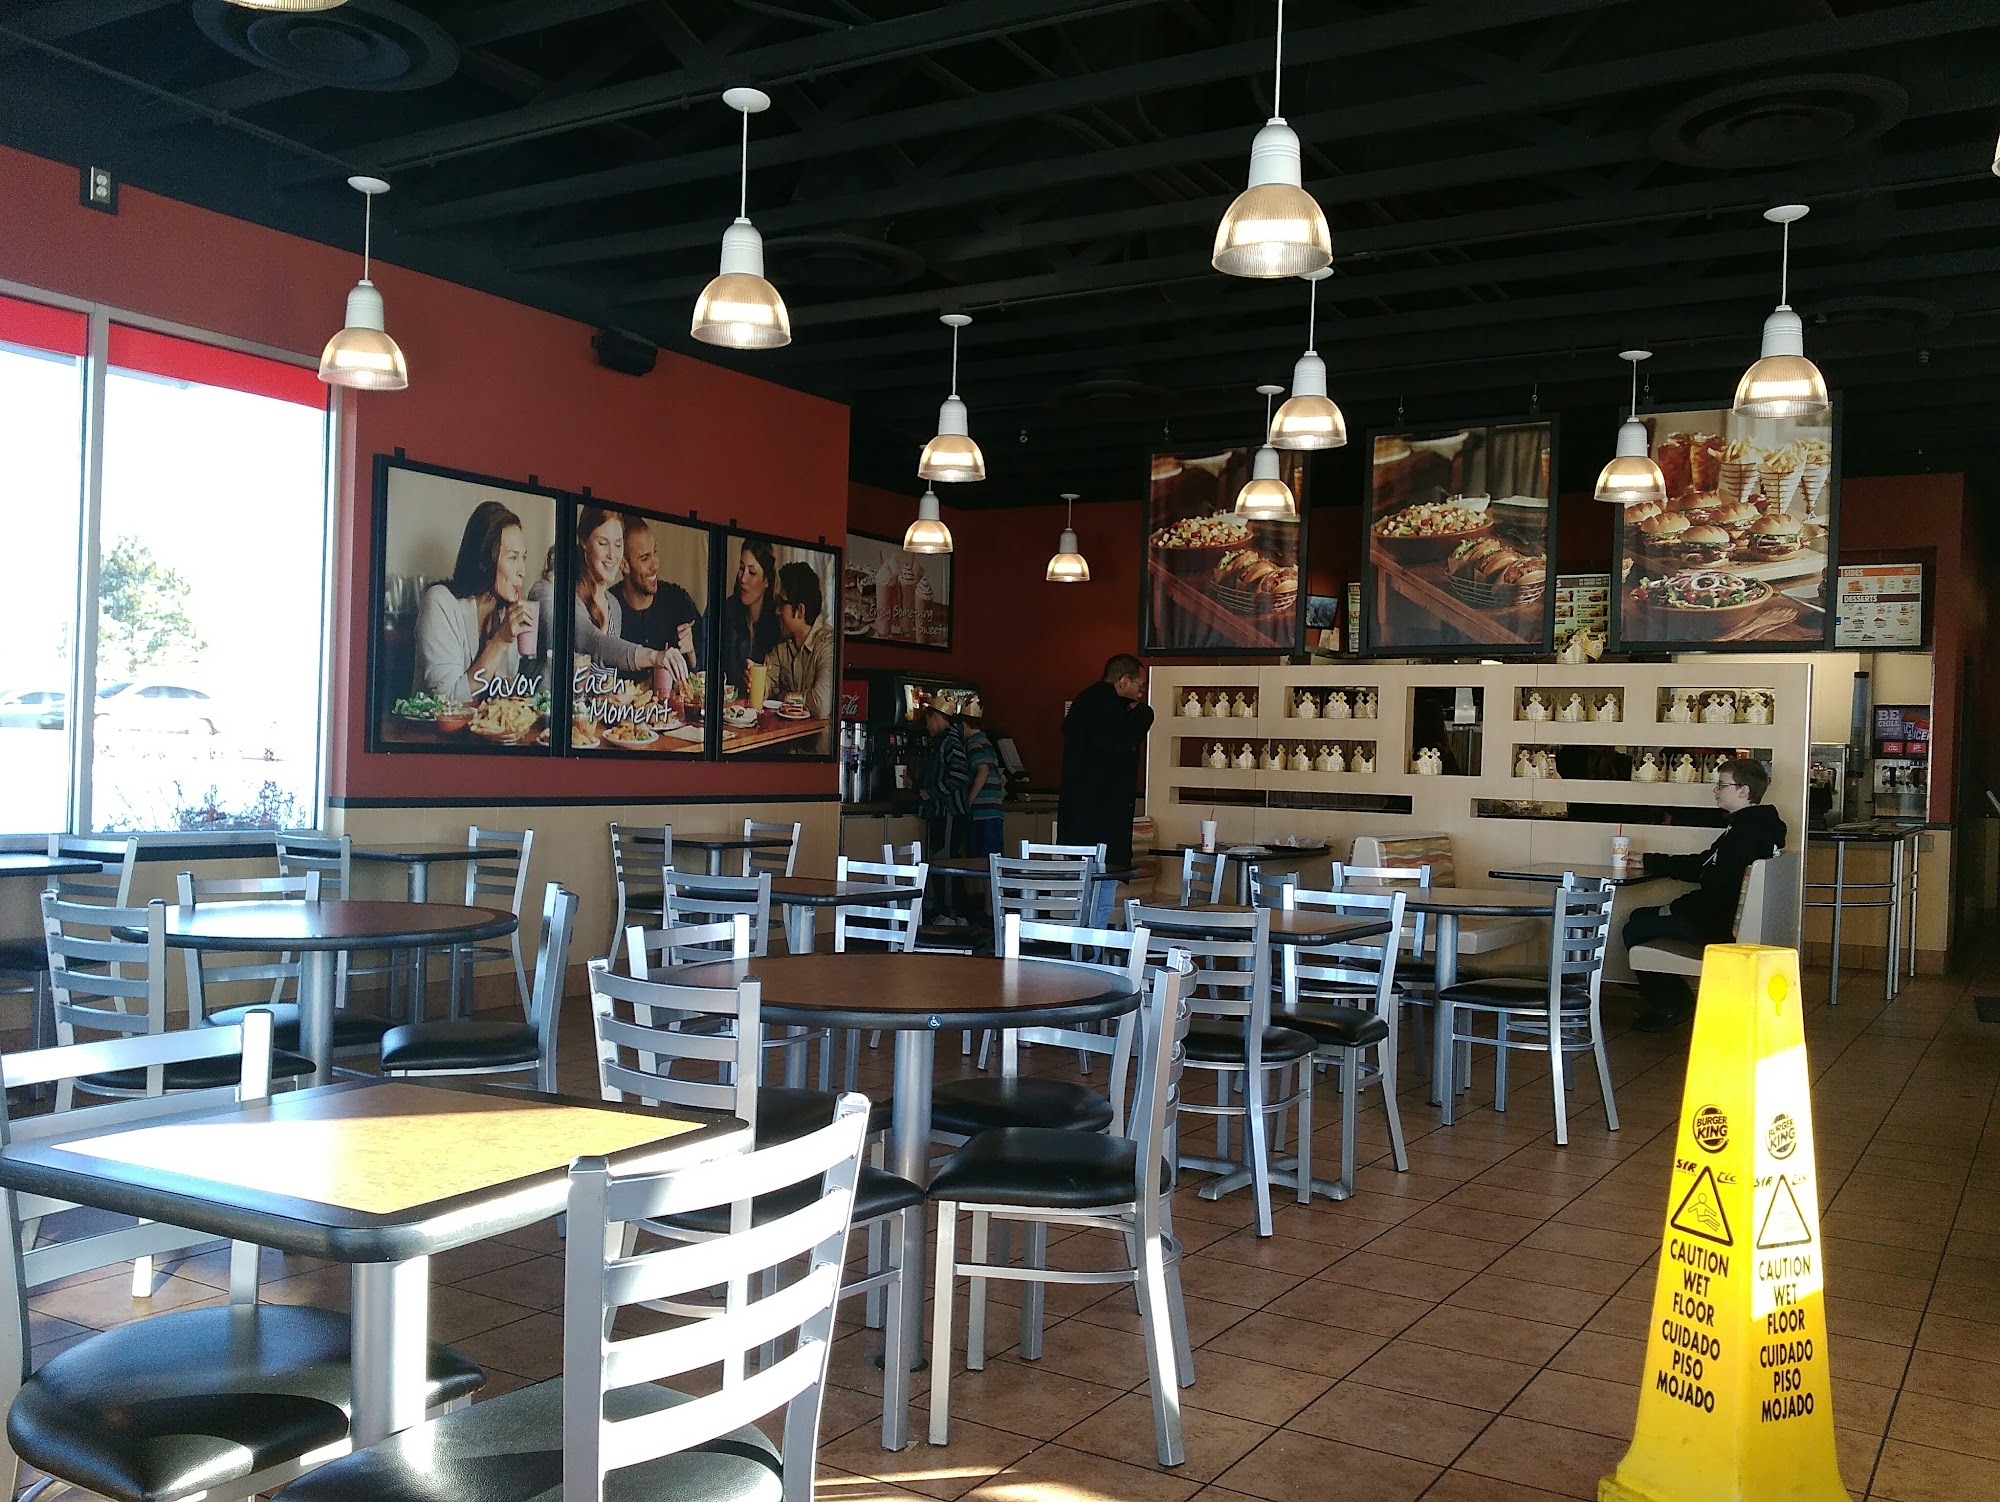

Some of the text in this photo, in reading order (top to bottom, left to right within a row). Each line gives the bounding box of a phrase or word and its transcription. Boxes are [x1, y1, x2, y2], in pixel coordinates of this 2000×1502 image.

[1844, 569, 1864, 577] SIDES
[1844, 595, 1878, 603] DESSERTS
[471, 667, 542, 698] Savor
[572, 666, 626, 695] Each
[588, 697, 672, 725] Moment
[1878, 709, 1899, 721] BE
[1696, 1116, 1728, 1128] BURGER
[1697, 1125, 1728, 1140] KING
[1768, 1119, 1793, 1139] BURGER
[1770, 1128, 1796, 1149] KING
[1670, 1238, 1729, 1278] CAUTION
[1759, 1255, 1811, 1281] CAUTION
[1683, 1268, 1711, 1298] WET
[1773, 1283, 1797, 1307] WET
[1672, 1292, 1715, 1327] FLOOR
[1767, 1308, 1806, 1335] FLOOR
[1662, 1319, 1720, 1361] CUIDADO
[1760, 1338, 1813, 1368] CUIDADO
[1672, 1349, 1703, 1381] PISO
[1656, 1369, 1715, 1414] MOJADO
[1773, 1367, 1801, 1393] PISO
[1761, 1392, 1814, 1423] MOJADO
